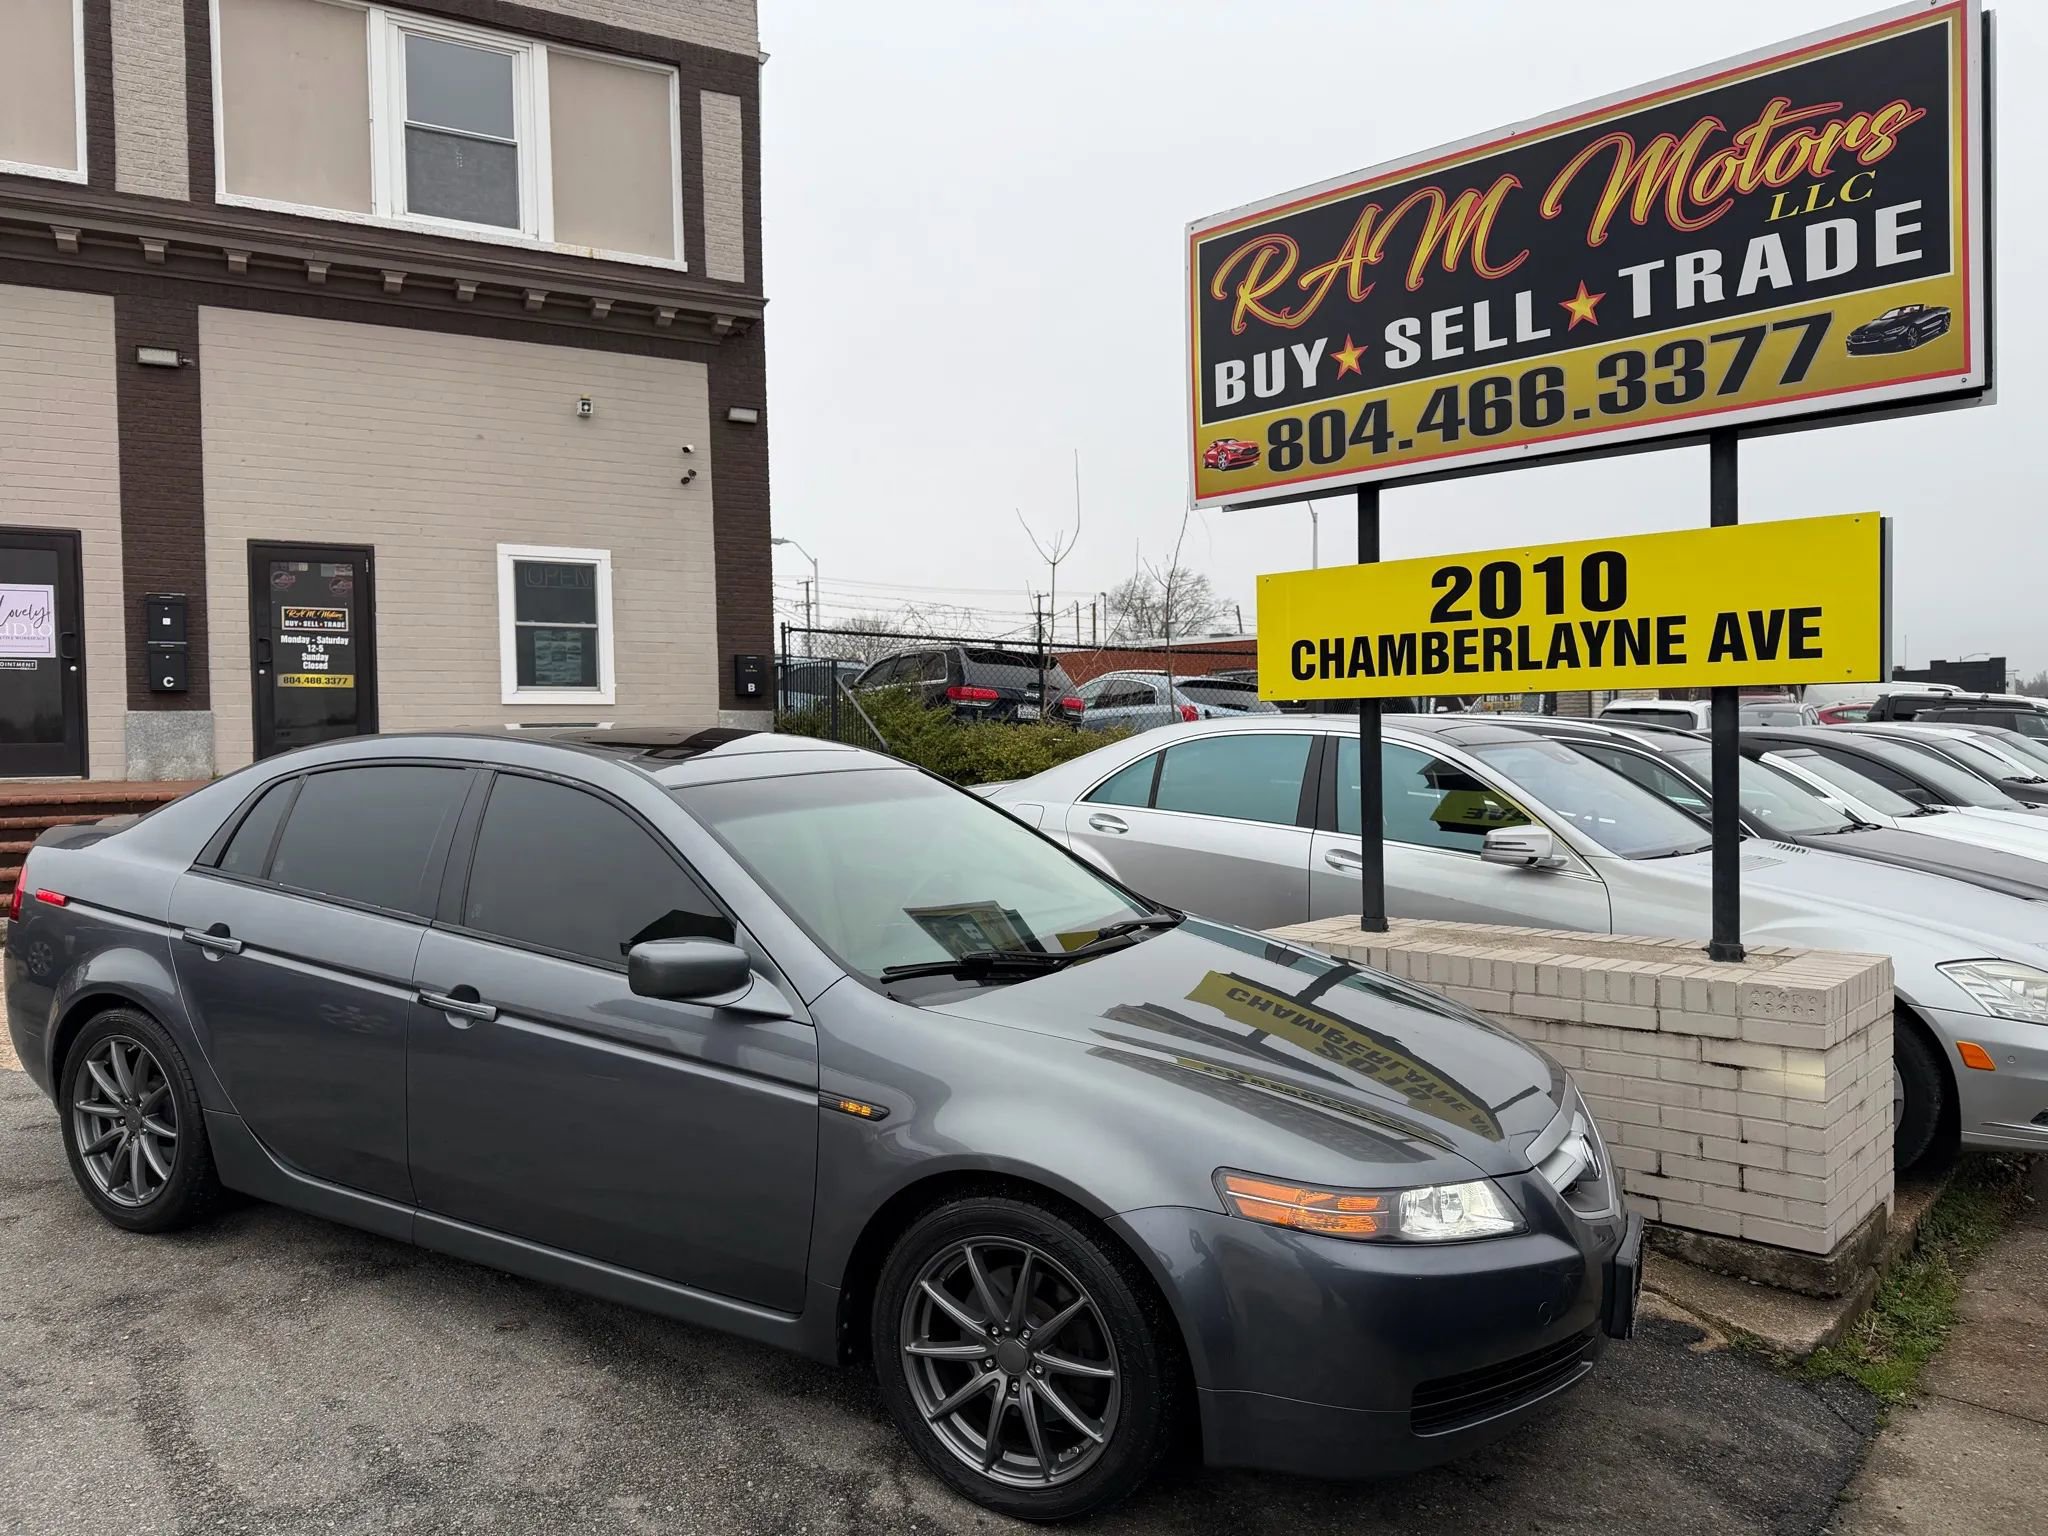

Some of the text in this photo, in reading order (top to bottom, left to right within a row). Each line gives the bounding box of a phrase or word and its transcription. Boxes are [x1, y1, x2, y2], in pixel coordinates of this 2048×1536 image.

[1764, 170, 1877, 222] LLC
[1210, 96, 1927, 335] RAM Motors
[1214, 199, 1923, 408] BUY SELL TRADE
[1266, 311, 1834, 473] 804.466.3377
[1430, 550, 1628, 624] 2010
[280, 634, 311, 645] Monday
[316, 635, 350, 646] Saturday
[307, 644, 325, 653] 12-5
[1290, 606, 1824, 682] CHAMBERLAYNE AVE
[301, 652, 330, 662] Sunday
[302, 661, 329, 670] Closed
[163, 676, 175, 688] C
[747, 682, 757, 693] B
